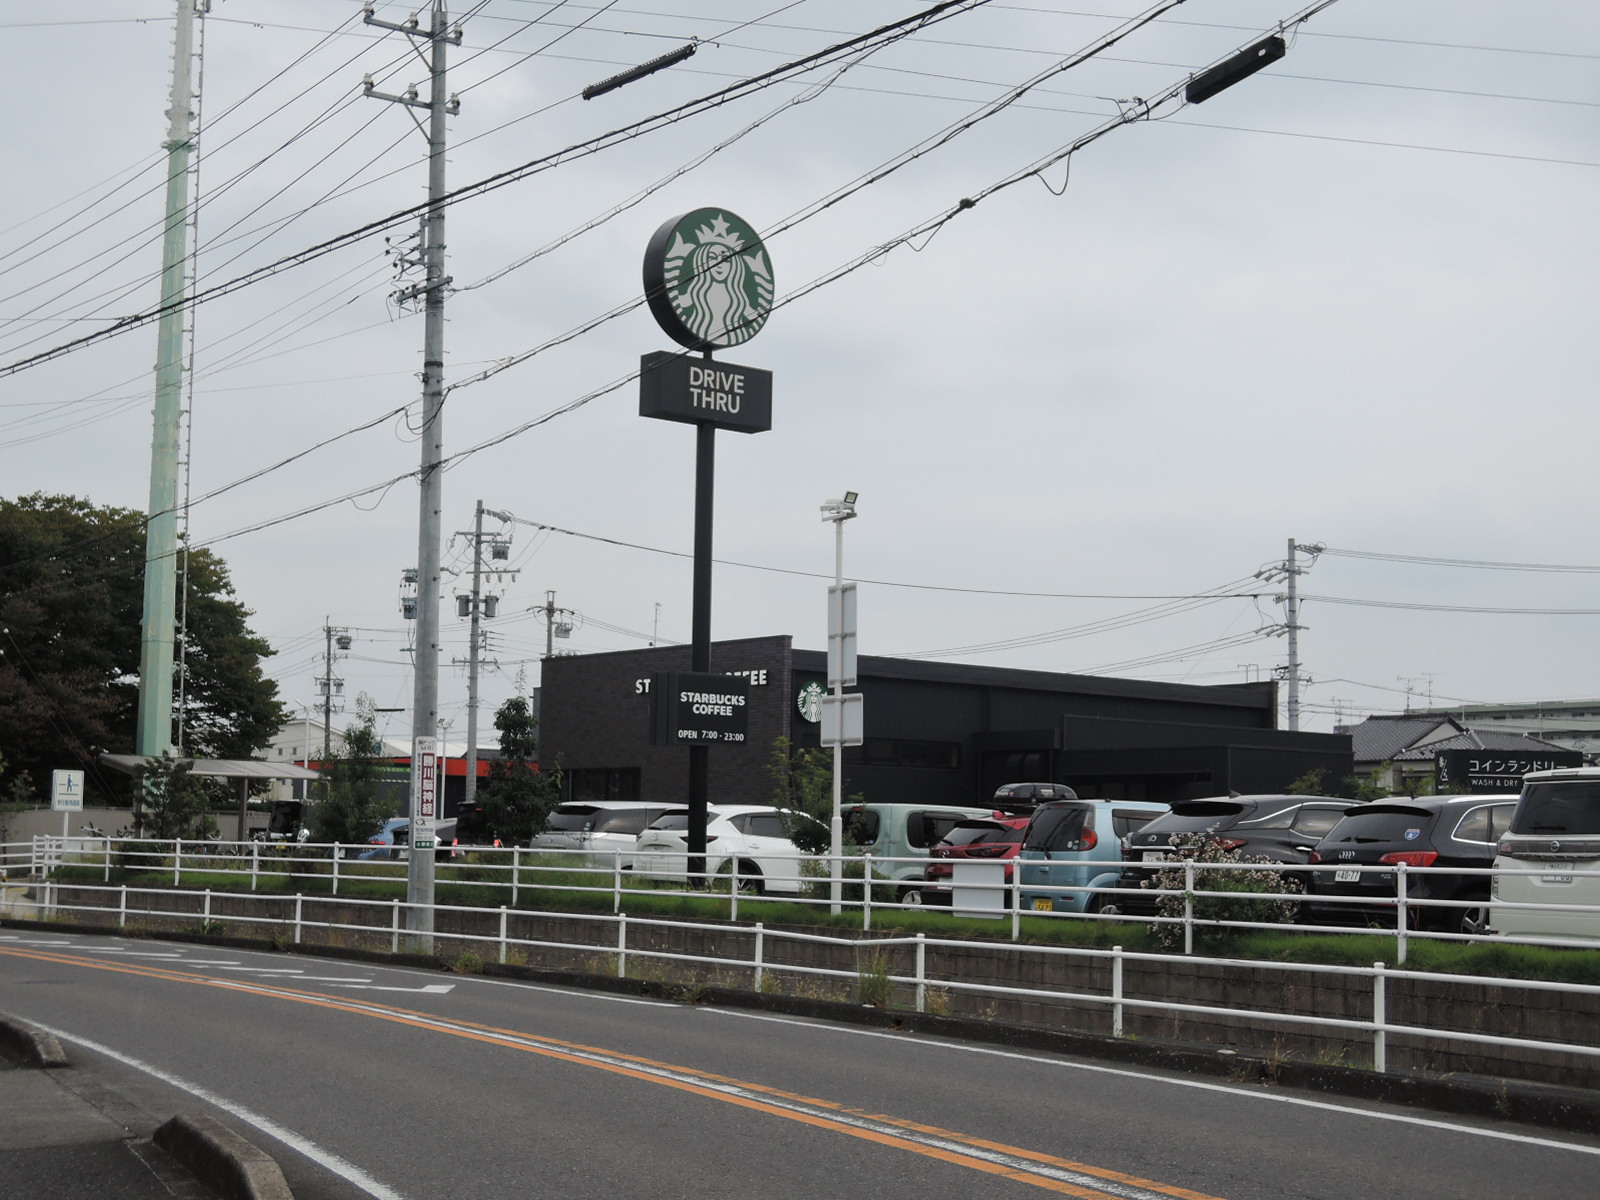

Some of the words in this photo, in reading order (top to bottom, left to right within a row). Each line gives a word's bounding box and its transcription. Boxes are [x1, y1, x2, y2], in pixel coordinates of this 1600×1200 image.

[689, 366, 745, 394] DRIVE
[689, 387, 741, 414] THRU
[680, 691, 746, 706] STARBUCKS
[692, 703, 733, 716] COFFEE
[677, 729, 698, 739] OPEN
[701, 729, 718, 739] 7:00
[723, 732, 745, 742] 23:00
[1469, 760, 1568, 773] コインランドリー
[1503, 779, 1518, 787] DRY
